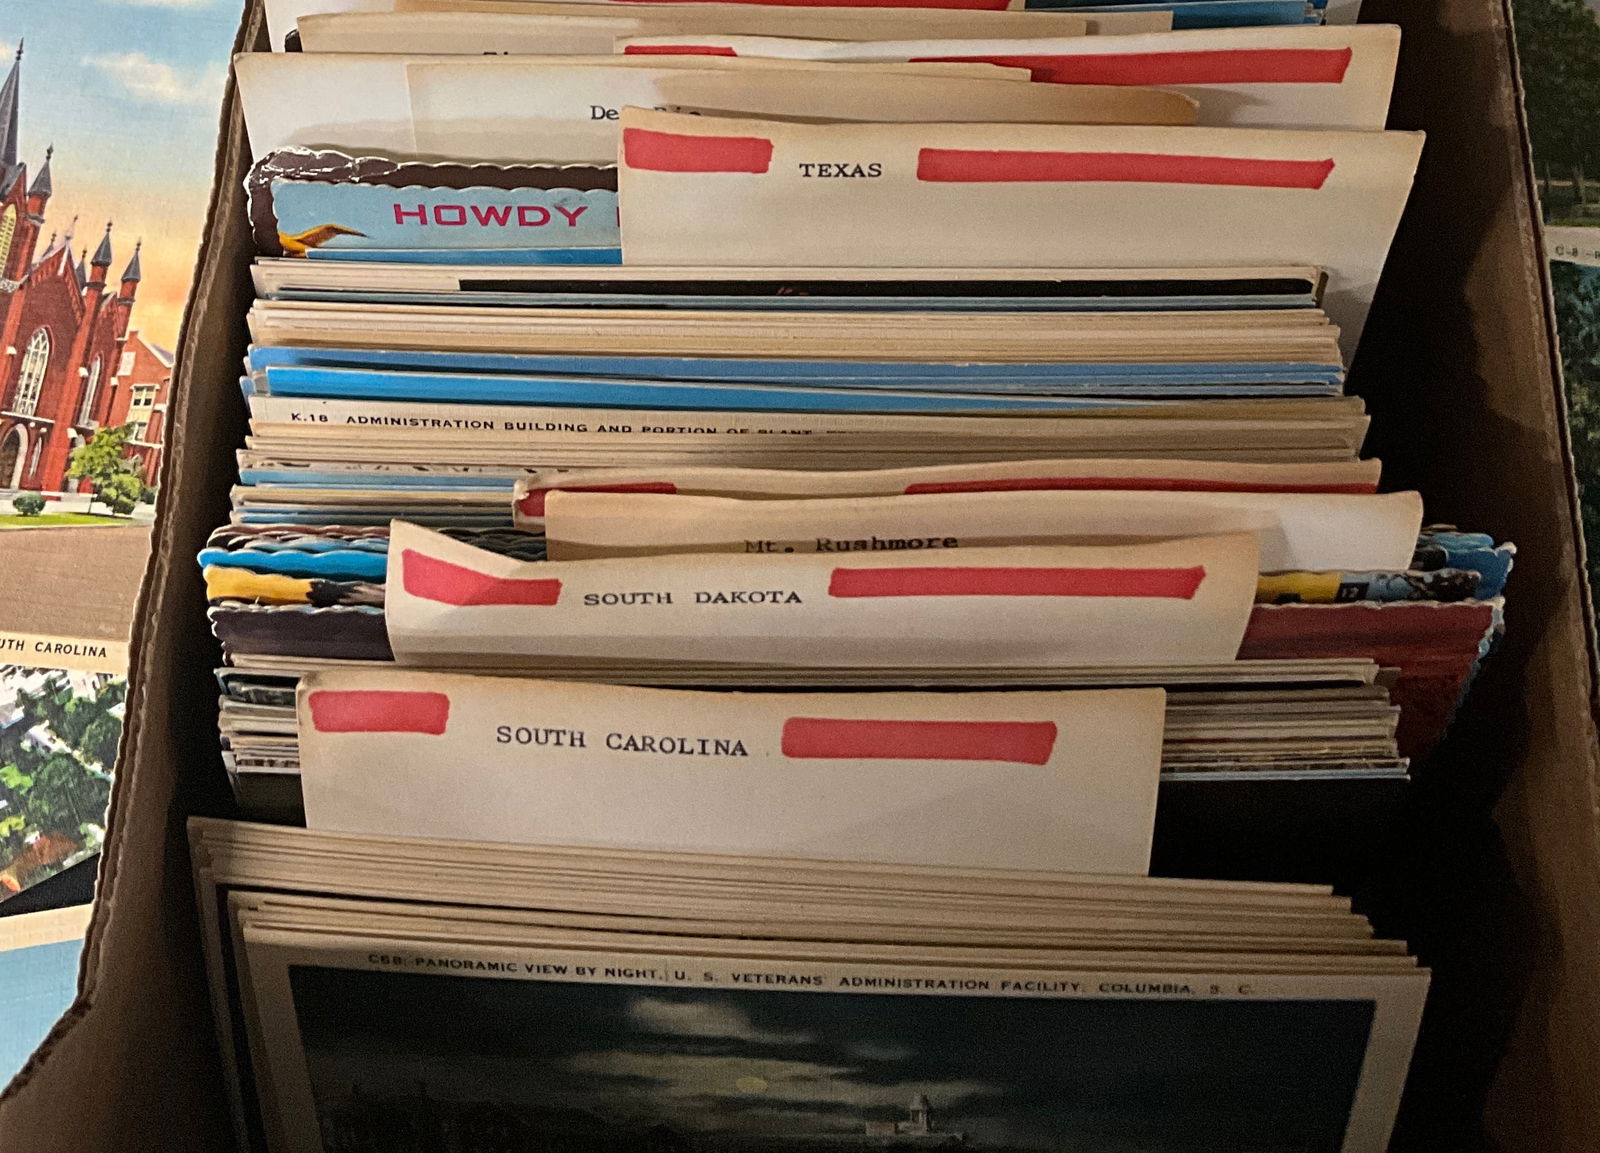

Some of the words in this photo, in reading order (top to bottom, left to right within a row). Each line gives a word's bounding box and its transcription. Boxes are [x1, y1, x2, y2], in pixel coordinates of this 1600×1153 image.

[798, 162, 882, 178] TEXAS
[393, 203, 589, 227] HOWDY
[346, 415, 494, 430] ADMINISTRATION
[504, 421, 588, 433] BUILDING
[597, 424, 632, 434] AND
[642, 425, 717, 434] PORTION
[744, 539, 794, 554] Mt.
[815, 536, 959, 552] Rushmore
[584, 592, 674, 606] SOUTH
[694, 590, 803, 604] DAKOTA
[35, 641, 107, 657] CAROLINA
[496, 725, 587, 748] SOUTH
[606, 732, 748, 757] CAROLINA
[415, 957, 518, 973] PANORAMIC
[524, 963, 568, 975] VIEW
[576, 966, 597, 977] BY
[839, 976, 990, 991] ADMINISTRATION
